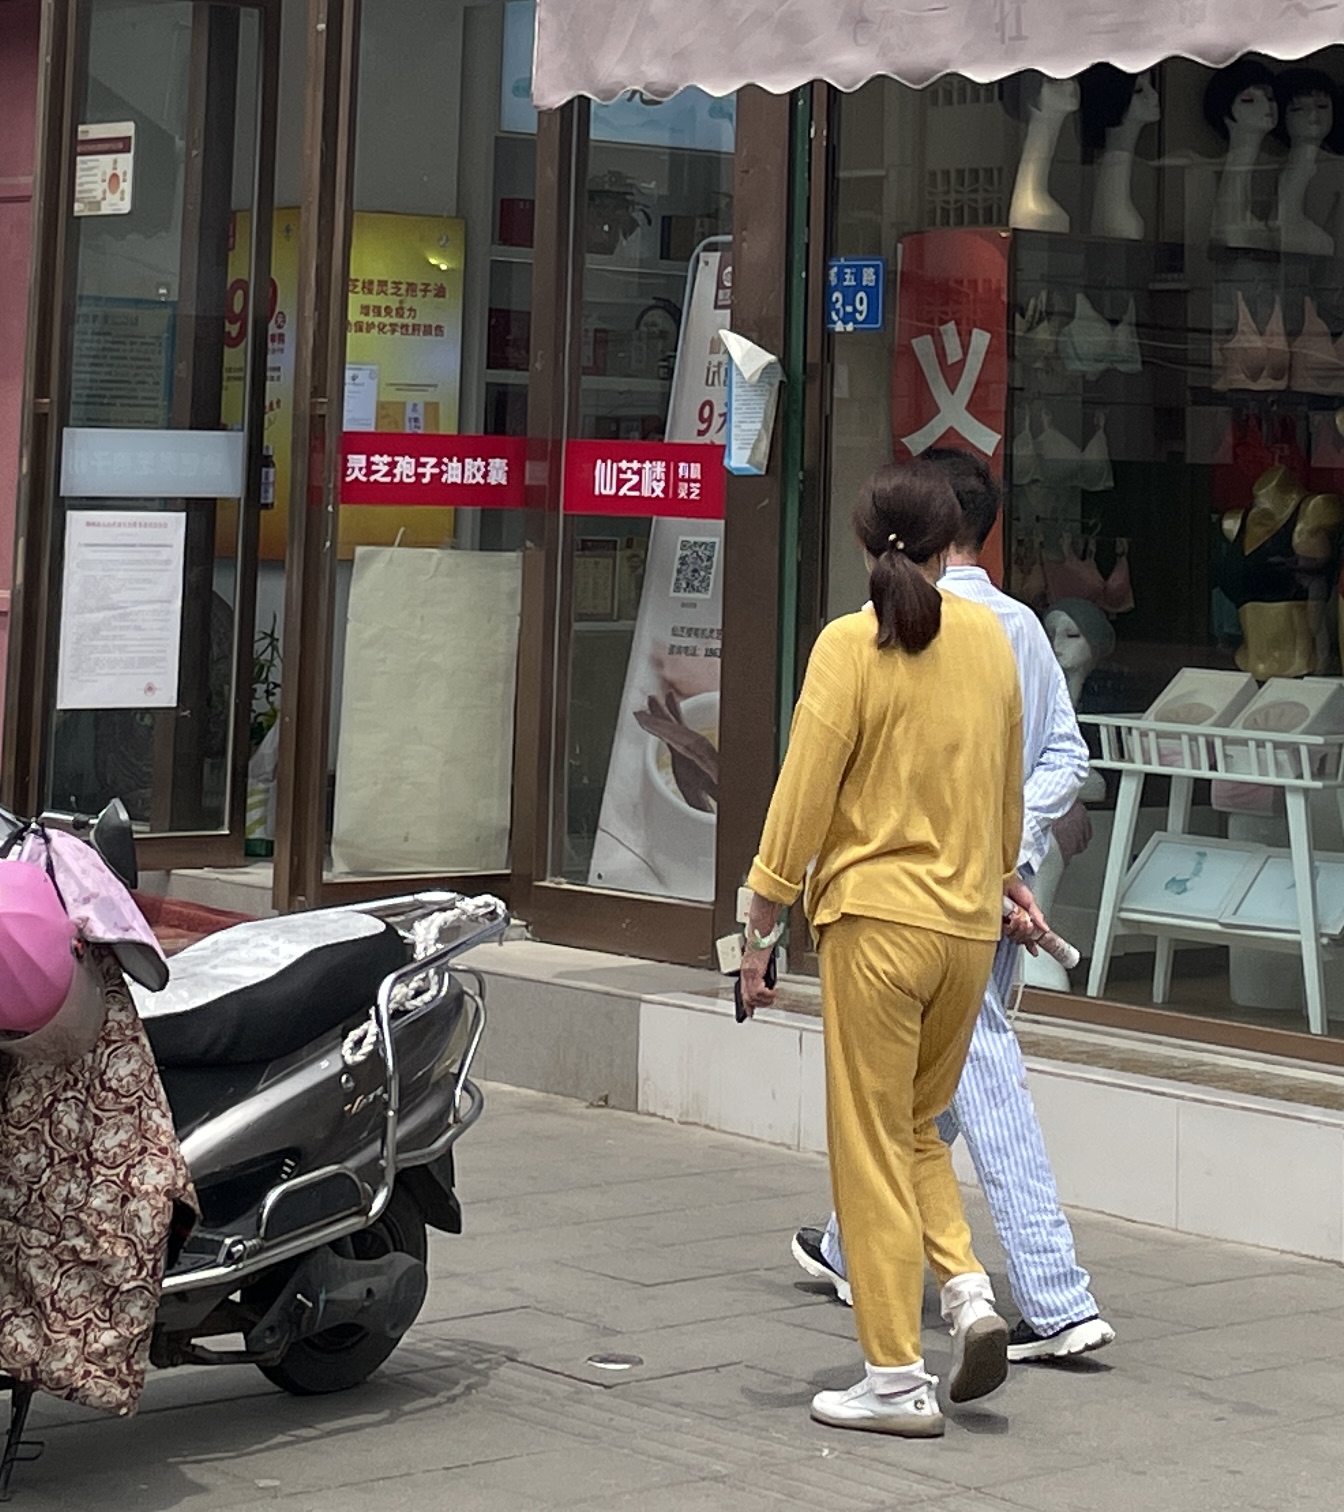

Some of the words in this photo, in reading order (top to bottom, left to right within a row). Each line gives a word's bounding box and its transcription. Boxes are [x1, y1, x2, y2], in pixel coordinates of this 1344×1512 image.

[901, 321, 1002, 457] 义
[345, 454, 509, 486] 灵芝孢子油胶囊
[594, 458, 667, 499] 仙芝楼
